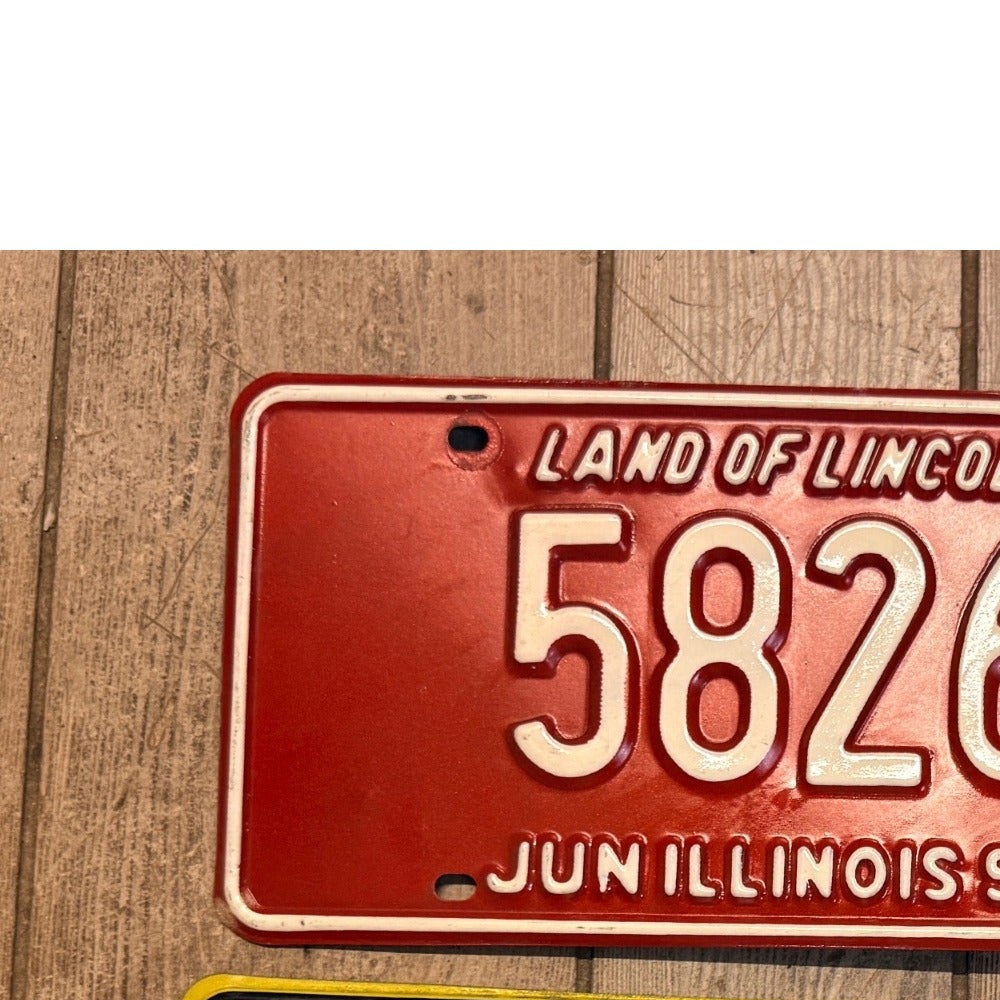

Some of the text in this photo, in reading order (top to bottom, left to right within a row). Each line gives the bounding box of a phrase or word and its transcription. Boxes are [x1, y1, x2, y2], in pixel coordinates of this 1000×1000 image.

[534, 427, 704, 486] LAND
[723, 430, 806, 487] OF
[488, 842, 640, 896] JUN
[663, 844, 958, 904] ILLINOIS
